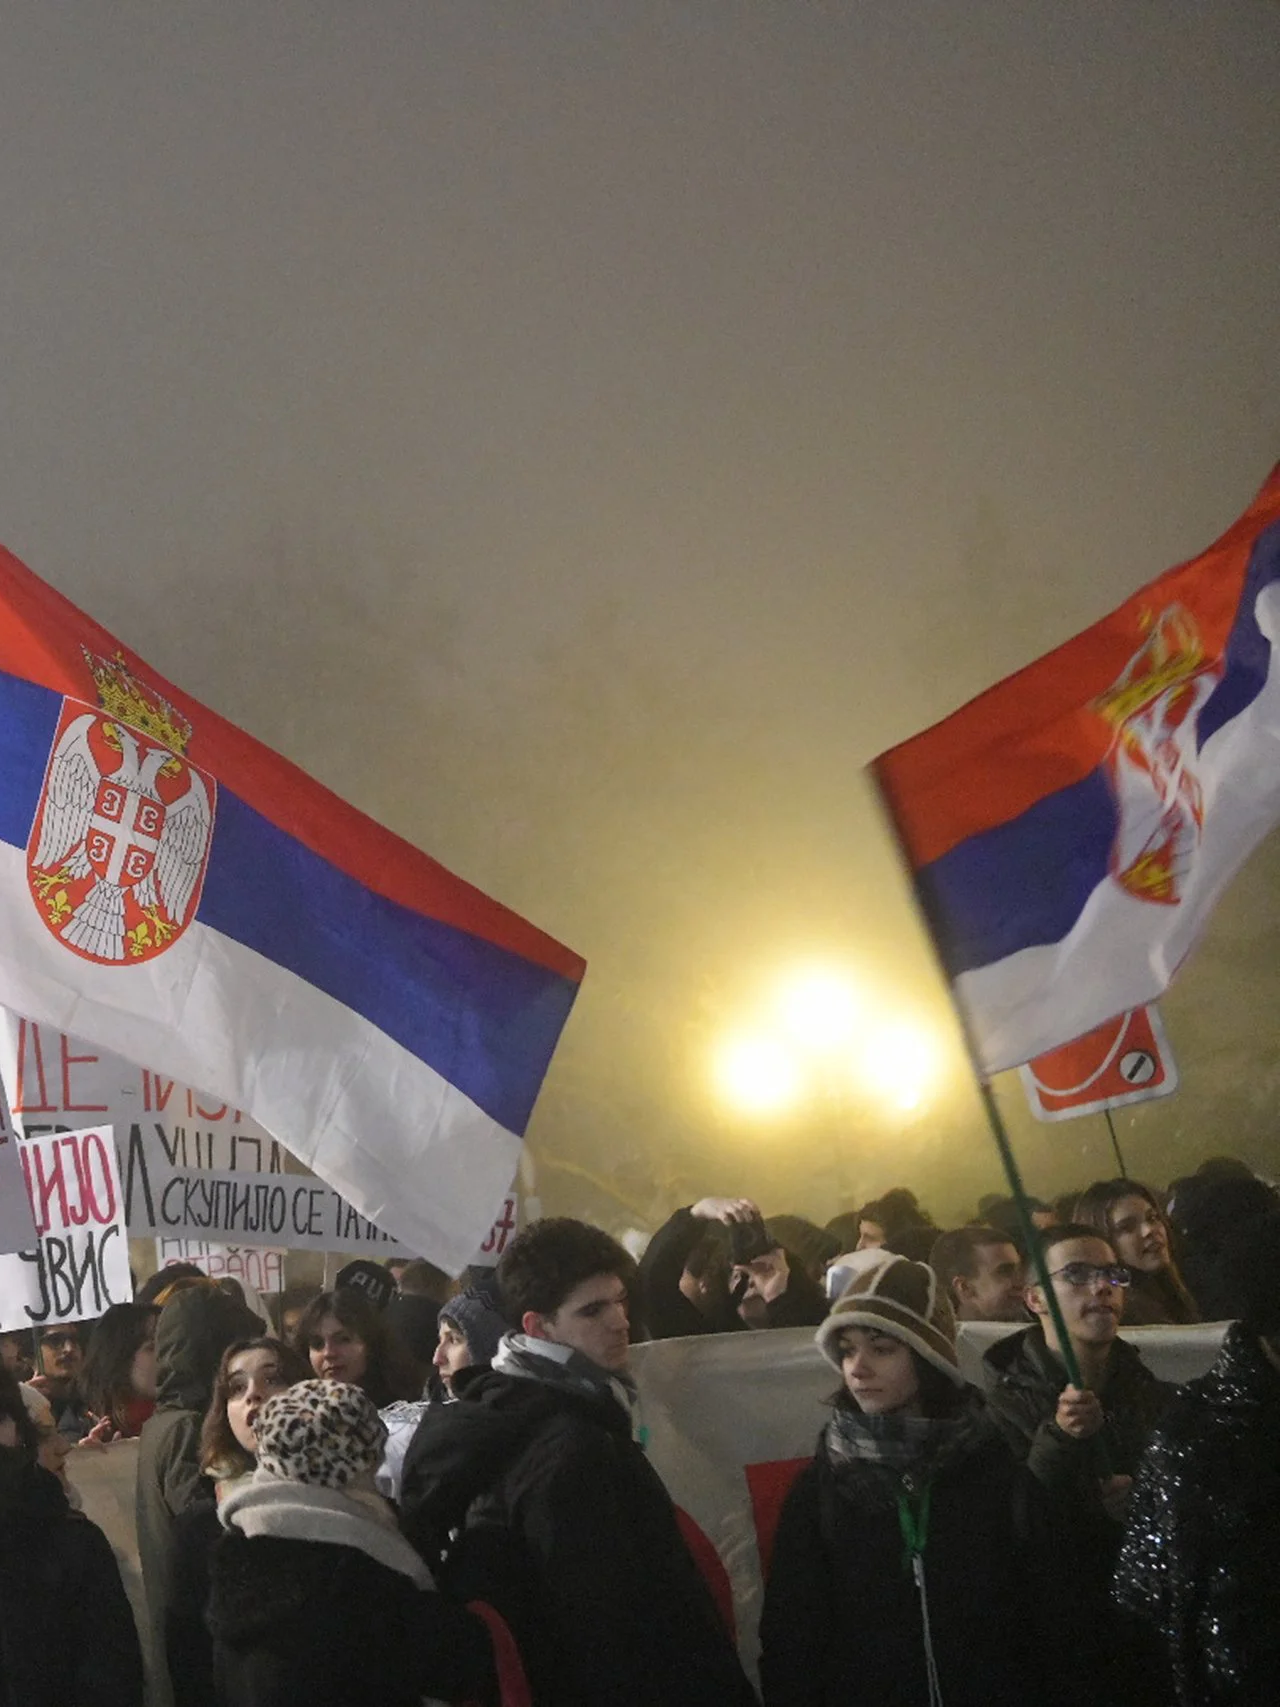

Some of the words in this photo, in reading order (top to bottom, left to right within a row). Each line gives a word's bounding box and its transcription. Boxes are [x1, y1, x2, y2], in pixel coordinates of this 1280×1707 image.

[161, 1176, 287, 1234] СКУПИЛО
[292, 1187, 324, 1236] СЕ
[18, 1224, 120, 1321] УВИС
